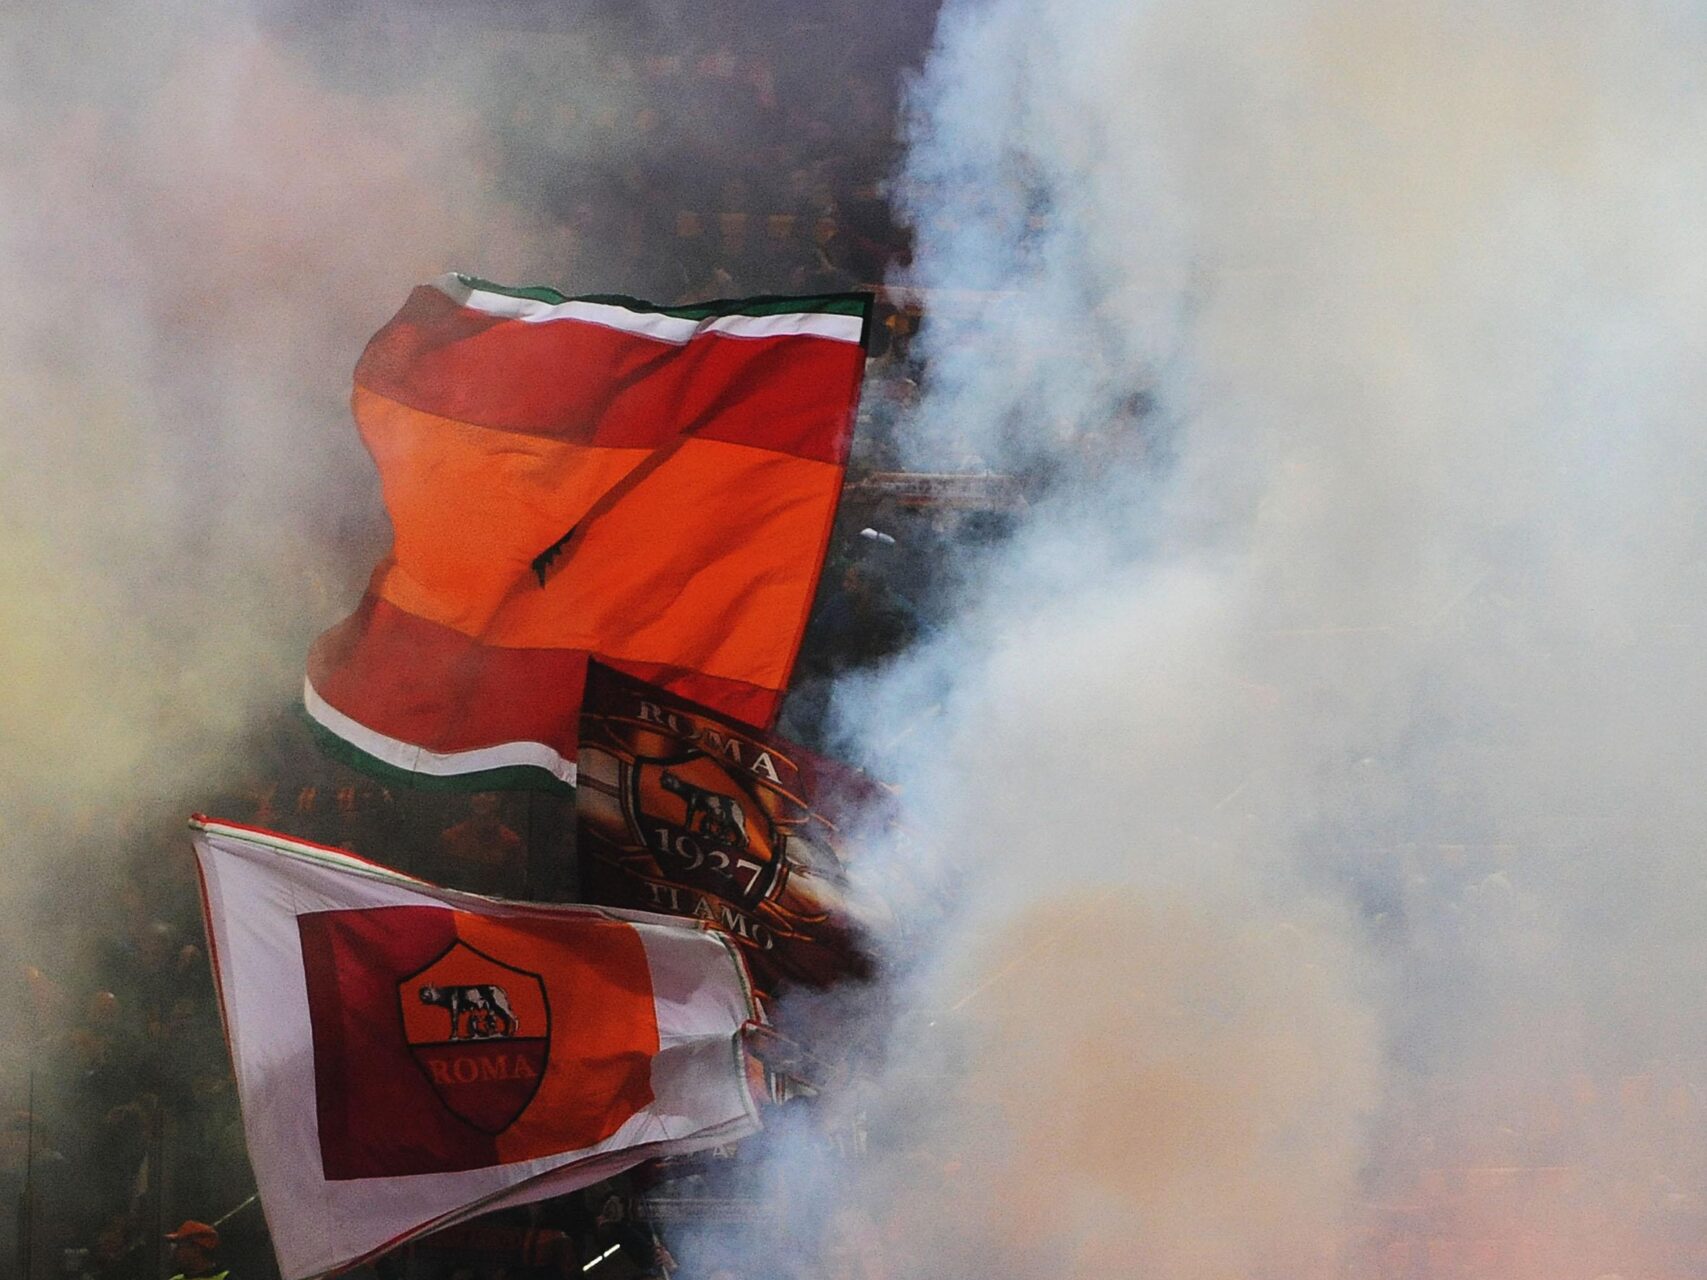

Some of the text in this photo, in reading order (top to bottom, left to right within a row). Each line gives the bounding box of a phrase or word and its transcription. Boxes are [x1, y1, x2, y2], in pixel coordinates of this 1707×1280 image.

[639, 701, 783, 784] ROMA
[654, 828, 763, 896] 1927
[644, 881, 775, 950] TI AMO
[428, 1054, 538, 1084] ROMA
